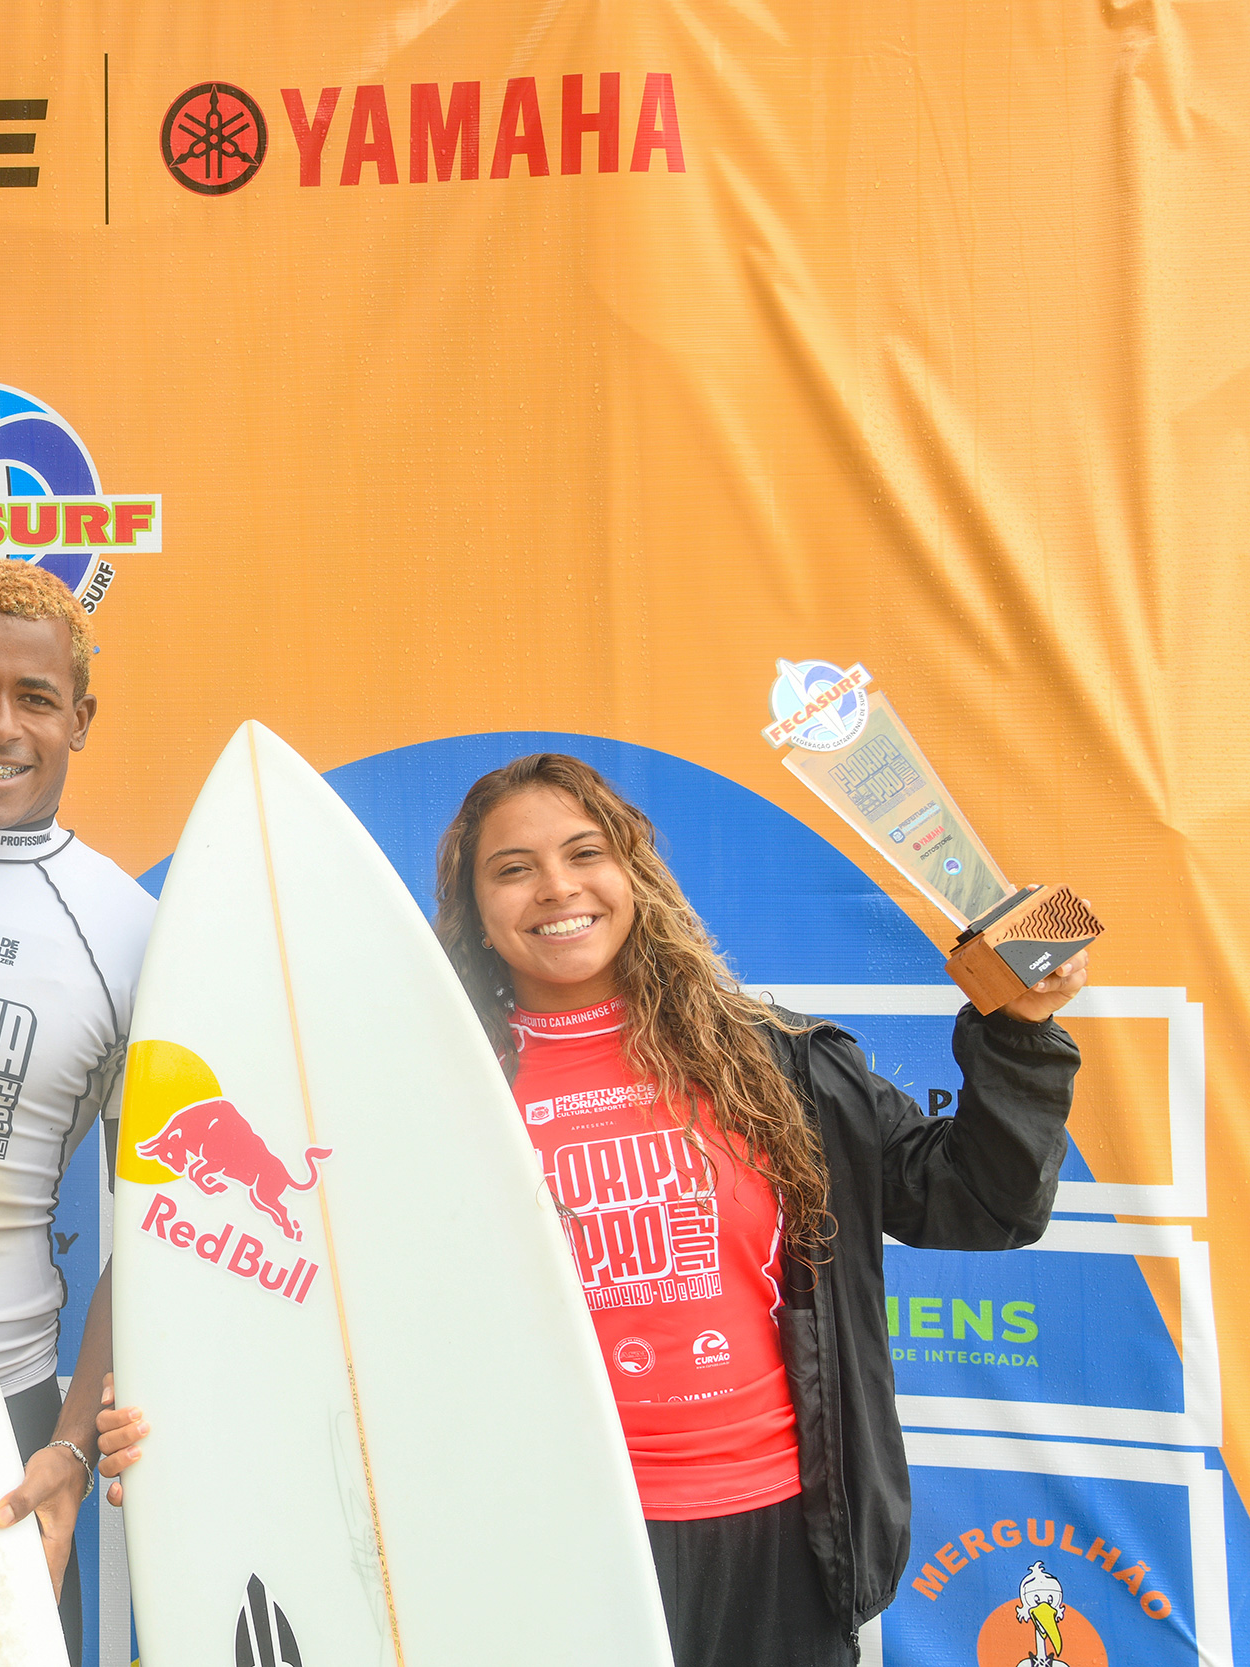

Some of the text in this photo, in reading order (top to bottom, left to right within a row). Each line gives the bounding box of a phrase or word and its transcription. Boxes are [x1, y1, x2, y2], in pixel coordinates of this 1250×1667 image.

[279, 71, 687, 188] YAMAHA
[81, 562, 114, 612] SURF
[769, 669, 862, 742] FECASURF
[832, 718, 864, 749] CATARINENSE
[828, 734, 901, 794] FLORIPA
[865, 766, 905, 804] PRO
[0, 832, 52, 847] PROFISSIONAL
[919, 825, 945, 846] YAMAHA
[920, 834, 953, 861] MOTOSTORE
[0, 936, 20, 951] DE
[519, 1013, 547, 1028] CIRCUITO
[549, 1004, 610, 1028] CATARINENSE
[555, 1083, 655, 1105] PREFEITURA DE
[594, 1103, 626, 1113] ESPORTE
[140, 1192, 319, 1305] Red Bull
[566, 1203, 673, 1288] PRO
[583, 1281, 654, 1310] ATADEIRO
[658, 1278, 676, 1303] 19
[695, 1352, 730, 1366] CURVÃO
[925, 1349, 1039, 1368] INTEGRADA
[911, 1517, 1172, 1620] MERGULHÃO
